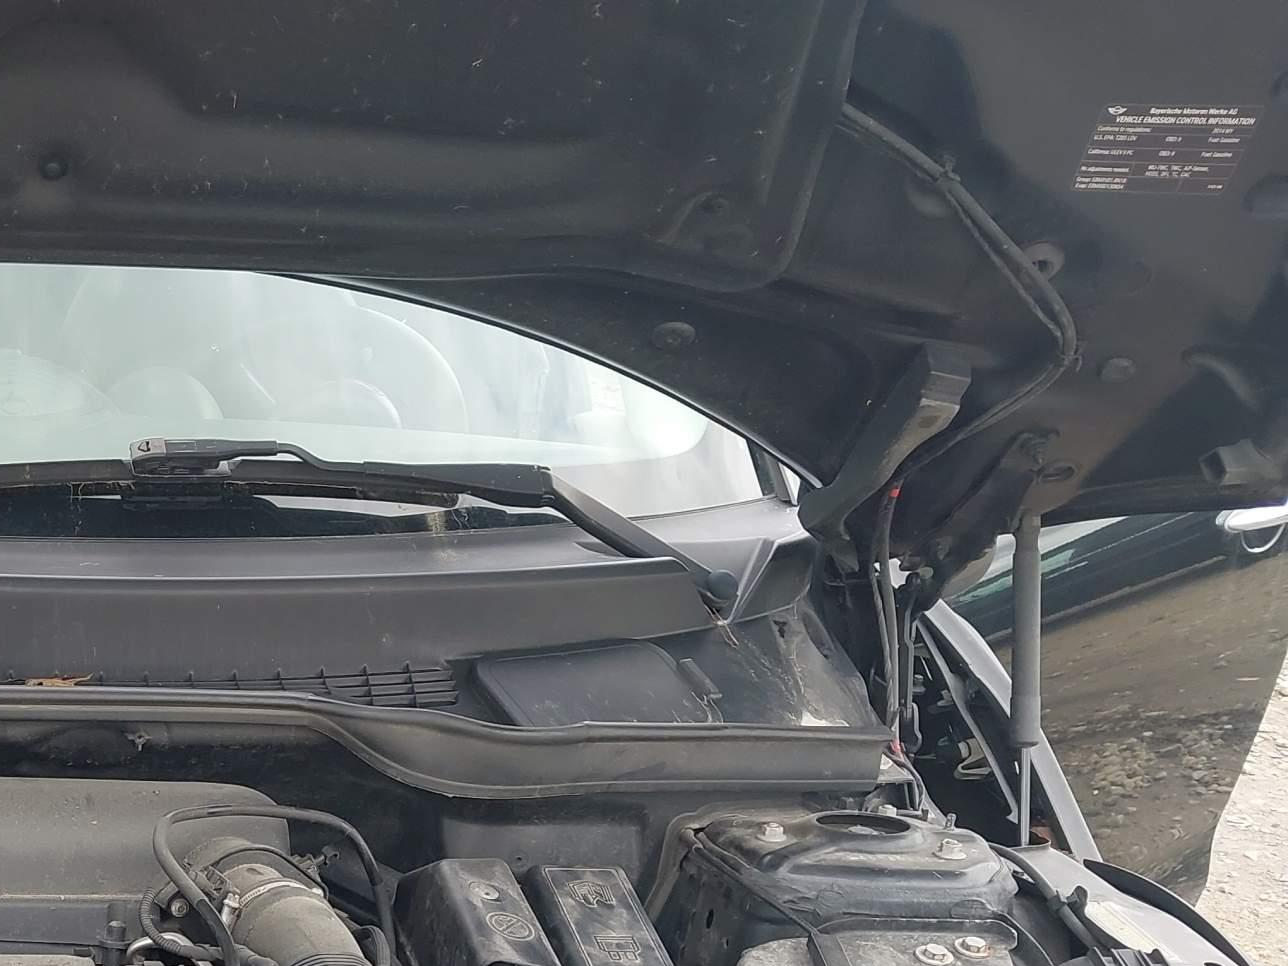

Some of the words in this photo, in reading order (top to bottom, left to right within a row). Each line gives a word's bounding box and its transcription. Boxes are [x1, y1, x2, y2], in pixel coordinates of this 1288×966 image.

[1150, 107, 1182, 115] Bayerische
[1116, 115, 1143, 123] VEHICLE
[1143, 116, 1176, 124] EMISSION
[1207, 117, 1256, 125] INFORMATION
